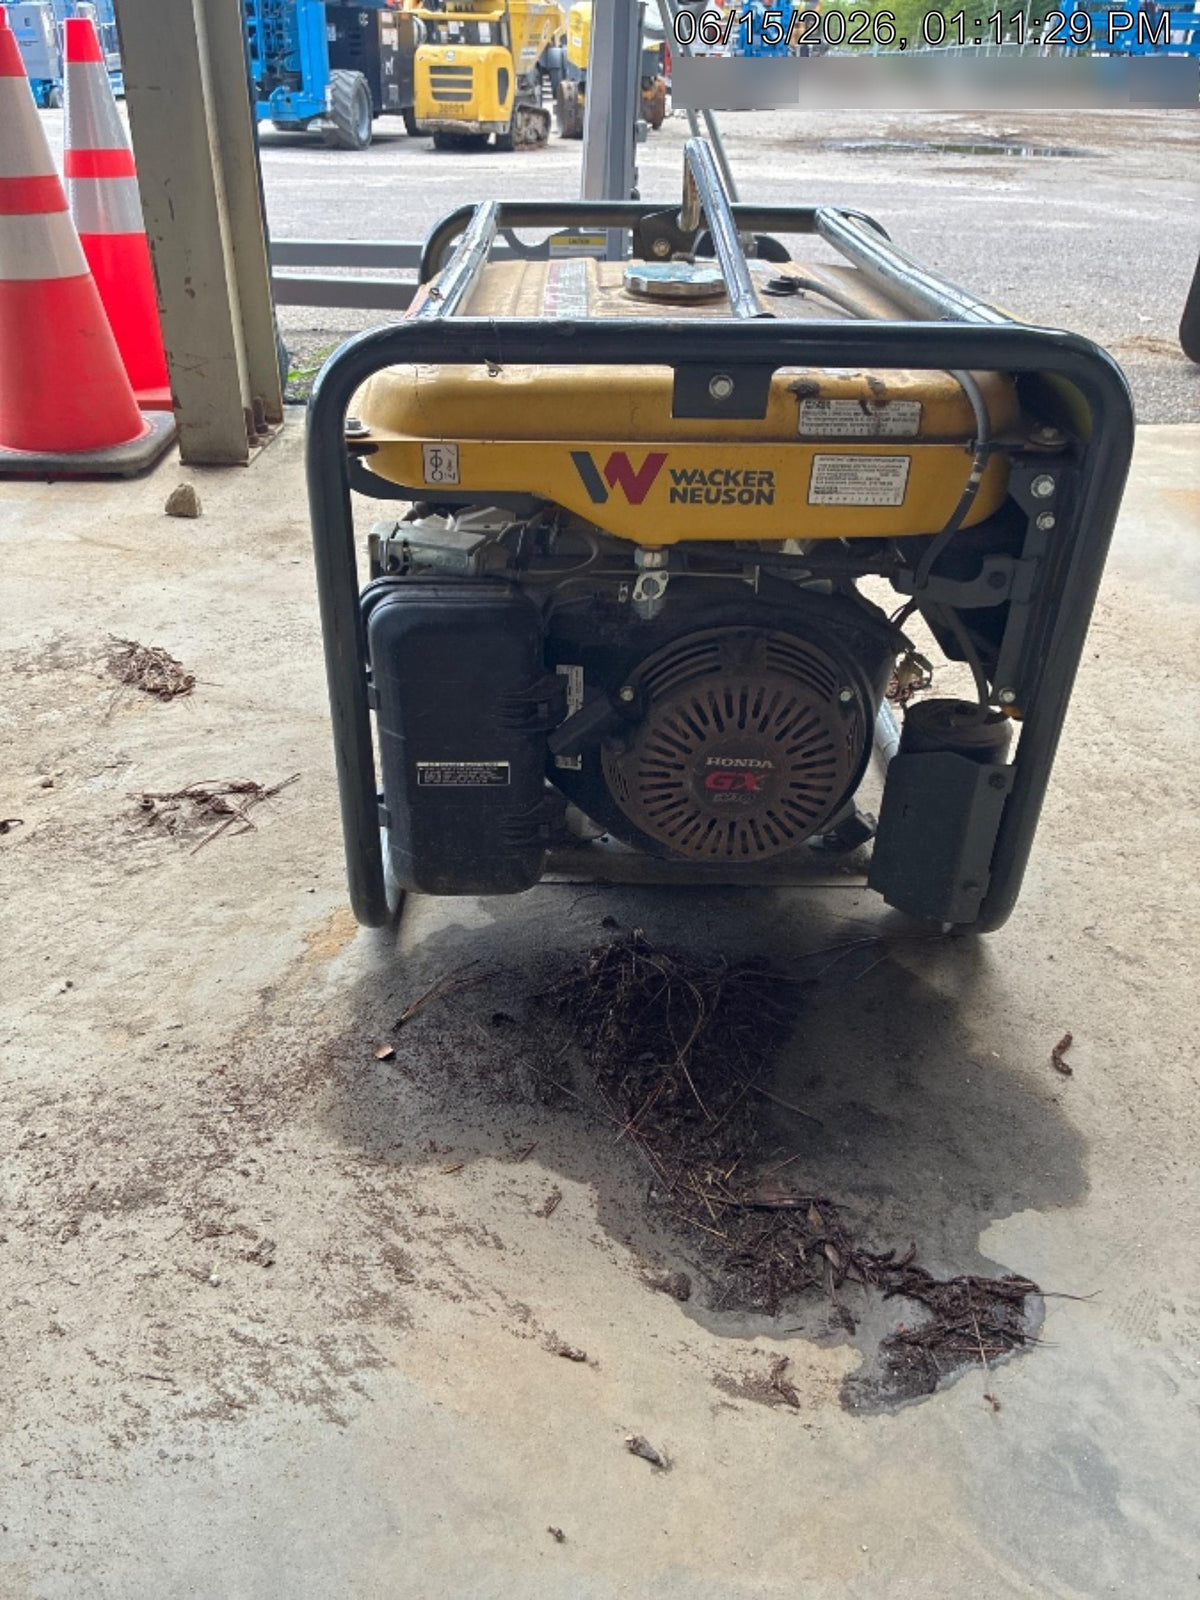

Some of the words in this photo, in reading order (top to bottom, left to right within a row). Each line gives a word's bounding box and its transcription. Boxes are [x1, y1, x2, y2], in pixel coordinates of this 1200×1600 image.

[669, 468, 776, 487] WACKER
[669, 487, 775, 505] NEUSON
[706, 757, 775, 769] HONDA
[704, 770, 763, 791] GX
